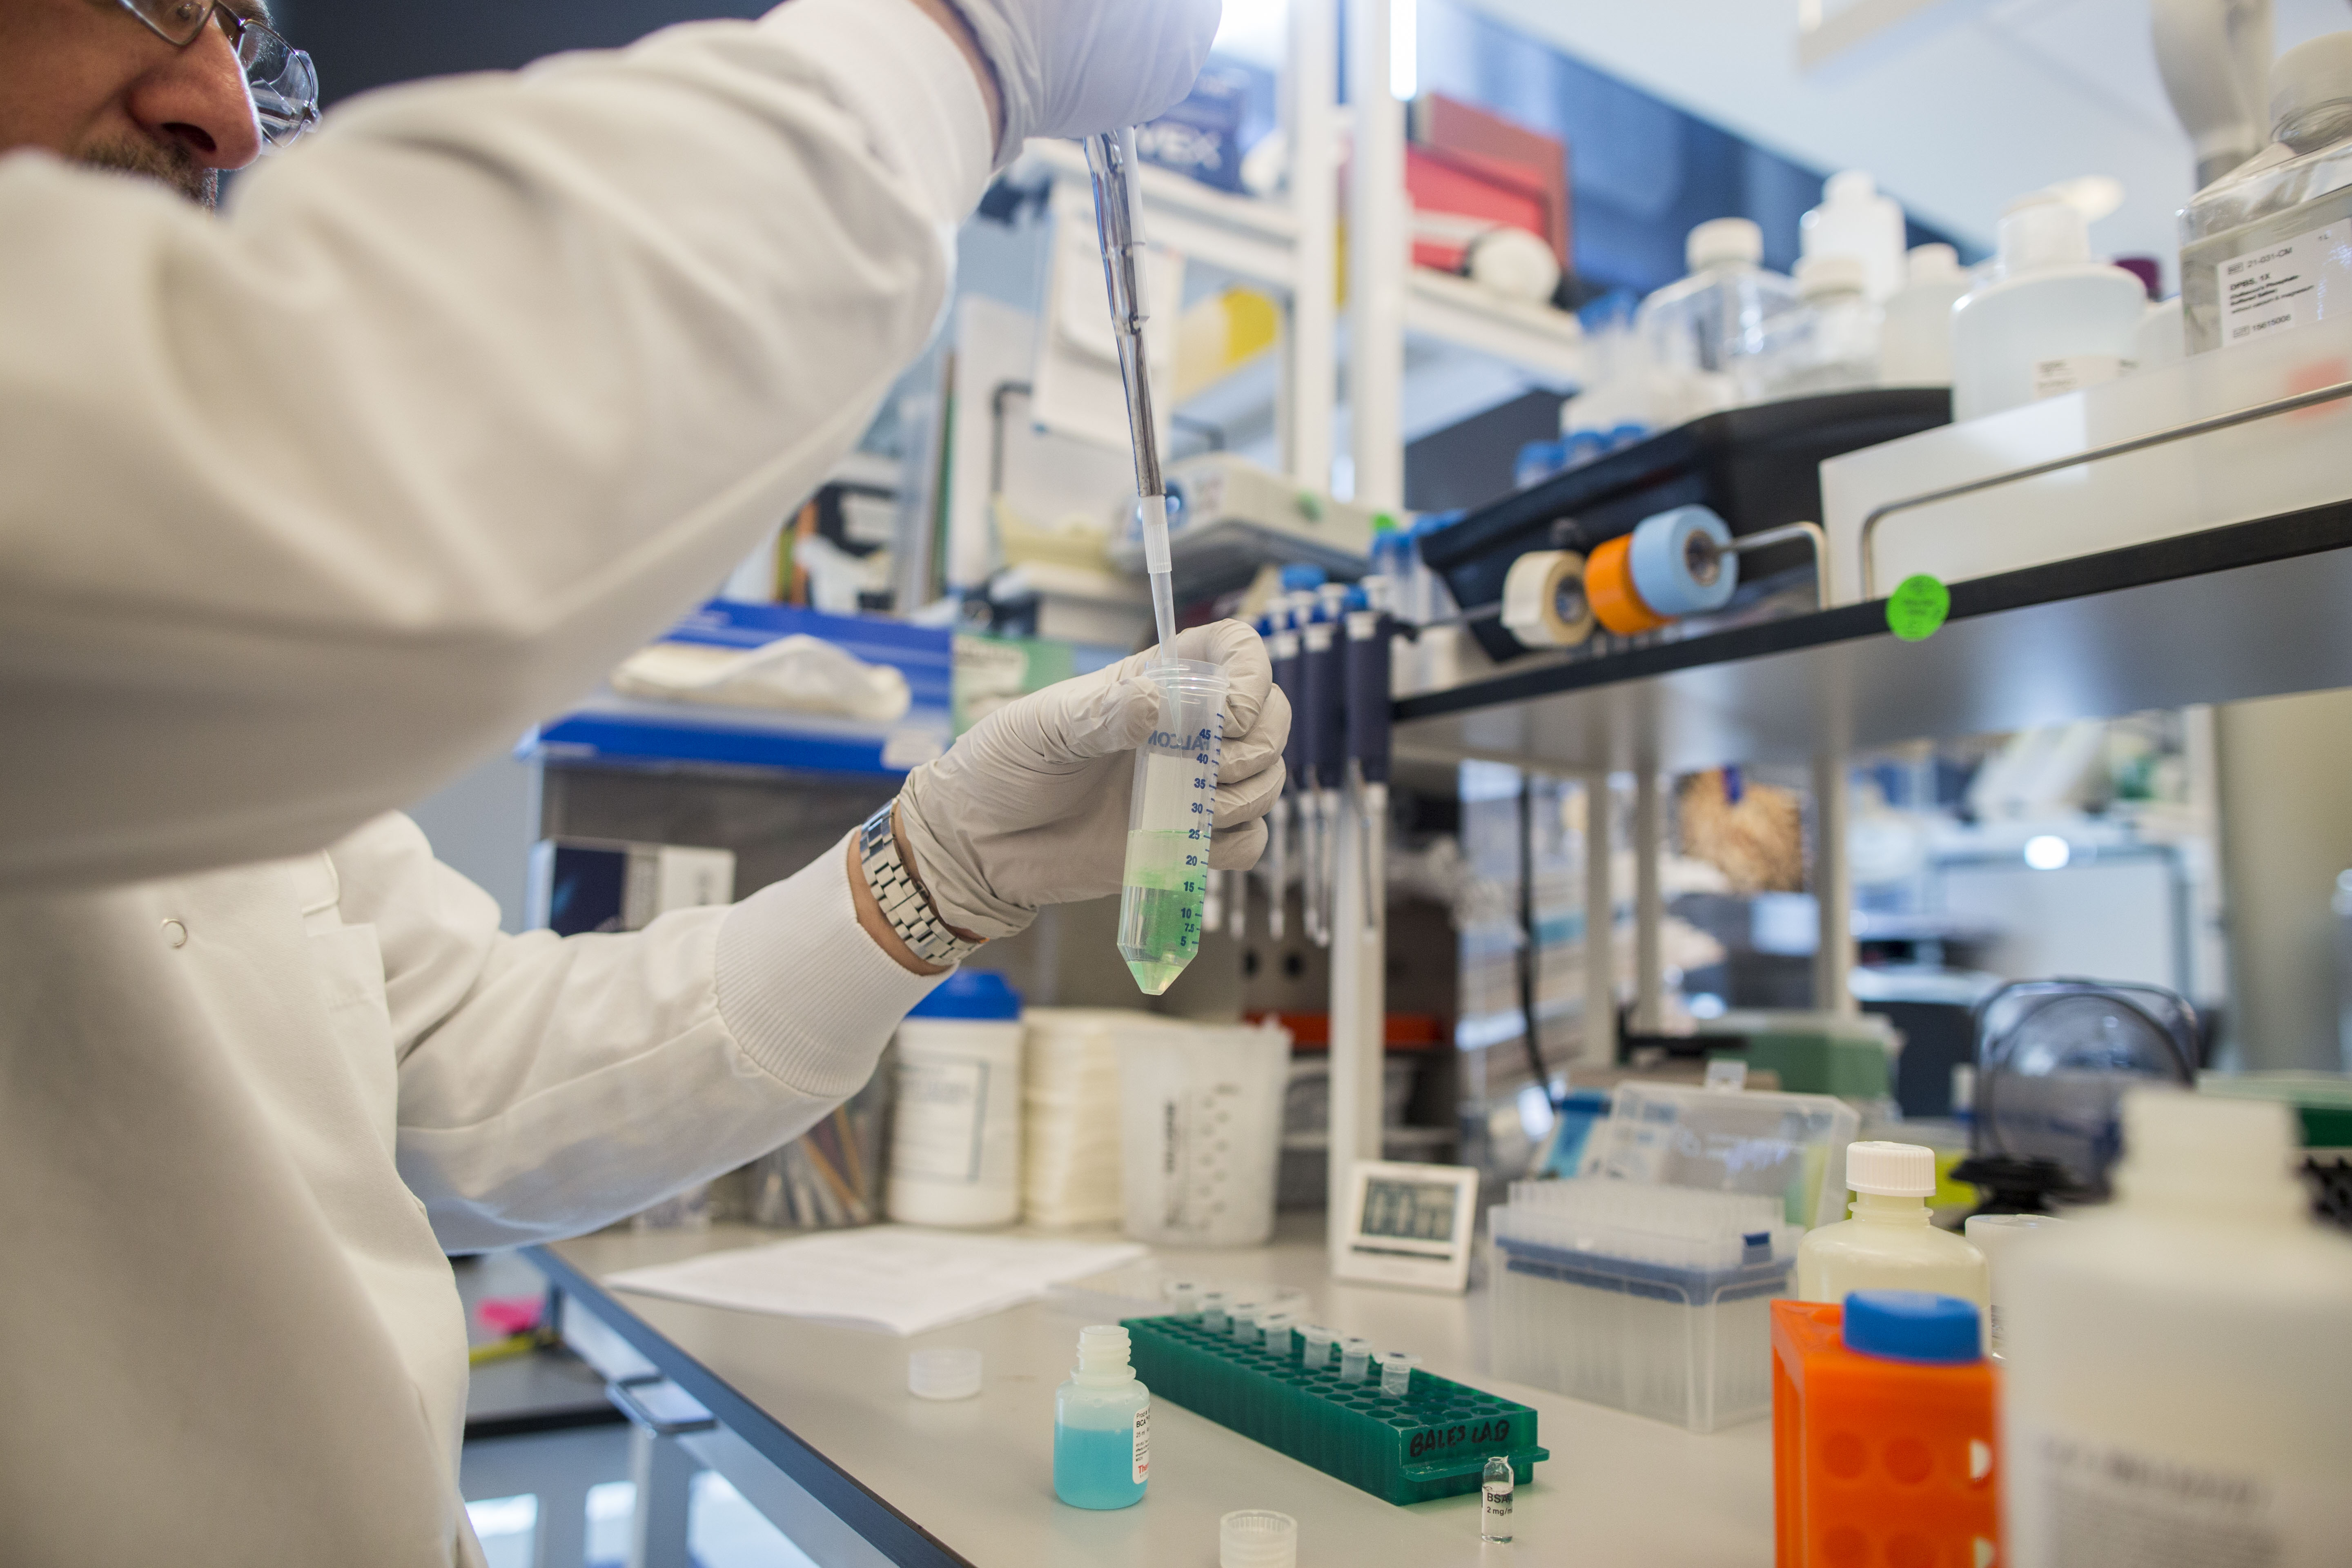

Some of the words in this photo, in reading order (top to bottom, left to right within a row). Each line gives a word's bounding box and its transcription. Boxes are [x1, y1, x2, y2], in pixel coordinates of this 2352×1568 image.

[1199, 728, 1211, 740] 45
[1196, 753, 1208, 764] 40
[1194, 777, 1206, 789] 35
[1191, 802, 1203, 814] 30
[1188, 829, 1200, 840] 25
[1186, 855, 1197, 866] 20
[1184, 881, 1194, 892] 15
[1181, 908, 1192, 918] 10
[1185, 923, 1194, 933] 7.5
[1180, 936, 1187, 946] 5
[1410, 1425, 1466, 1457] BALES
[1472, 1419, 1509, 1443] LAB
[1487, 1492, 1508, 1503] BSA
